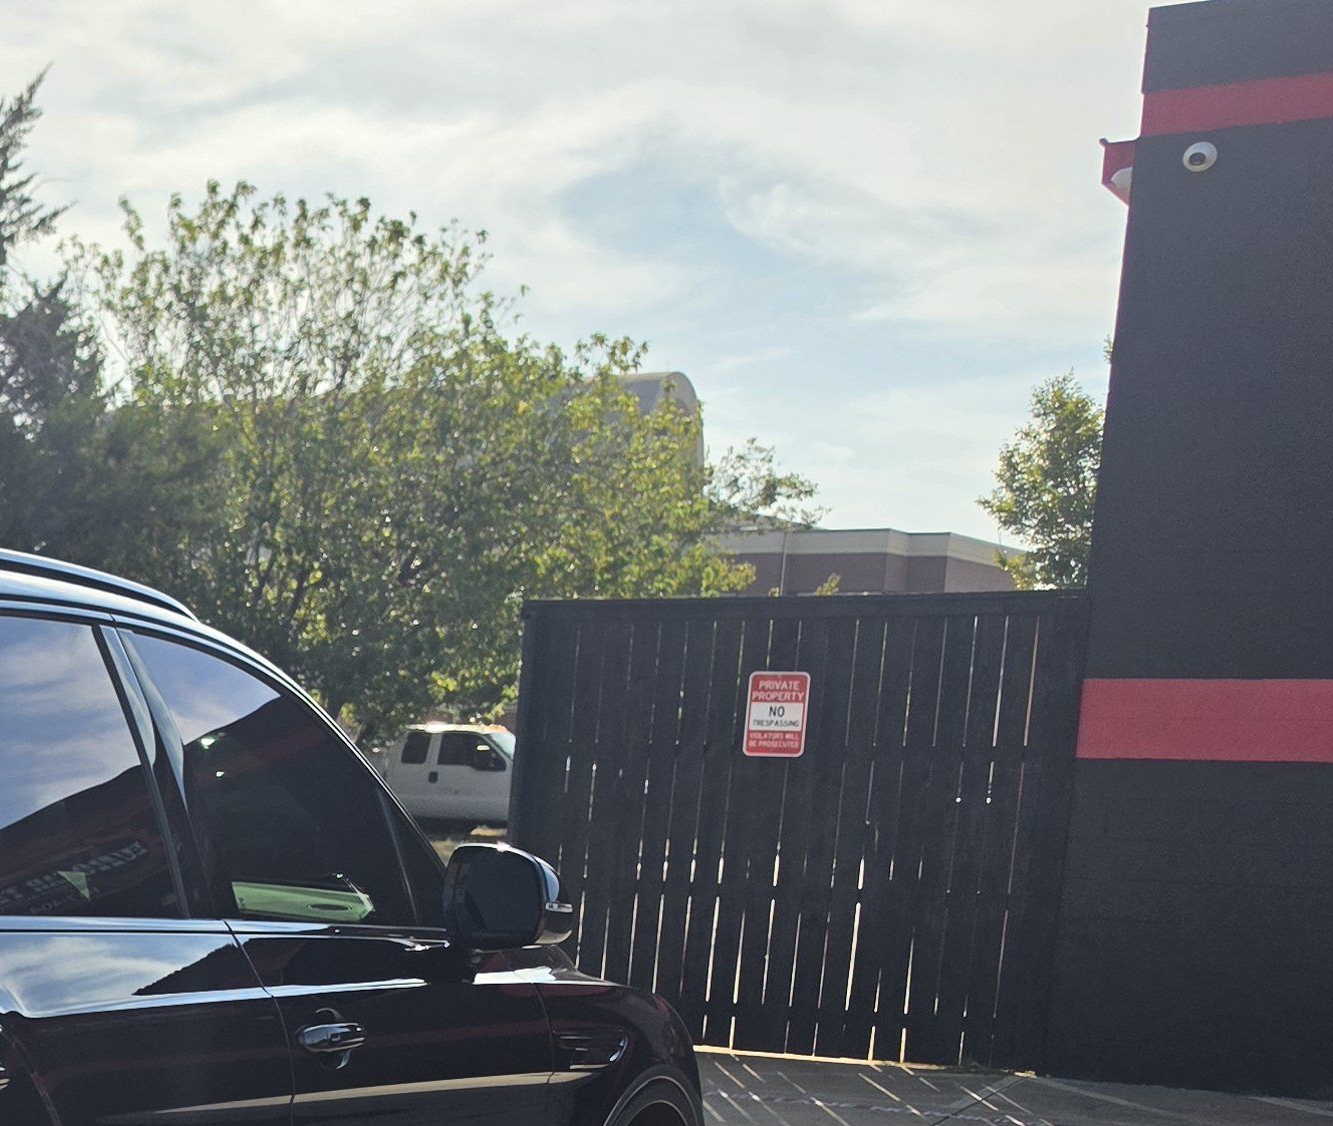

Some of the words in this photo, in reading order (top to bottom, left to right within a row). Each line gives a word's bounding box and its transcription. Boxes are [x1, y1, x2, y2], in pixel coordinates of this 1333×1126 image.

[758, 680, 801, 691] PRIVATE
[752, 690, 805, 701] PROPERTY
[769, 705, 786, 718] NO
[752, 719, 800, 728] TRESPASSING
